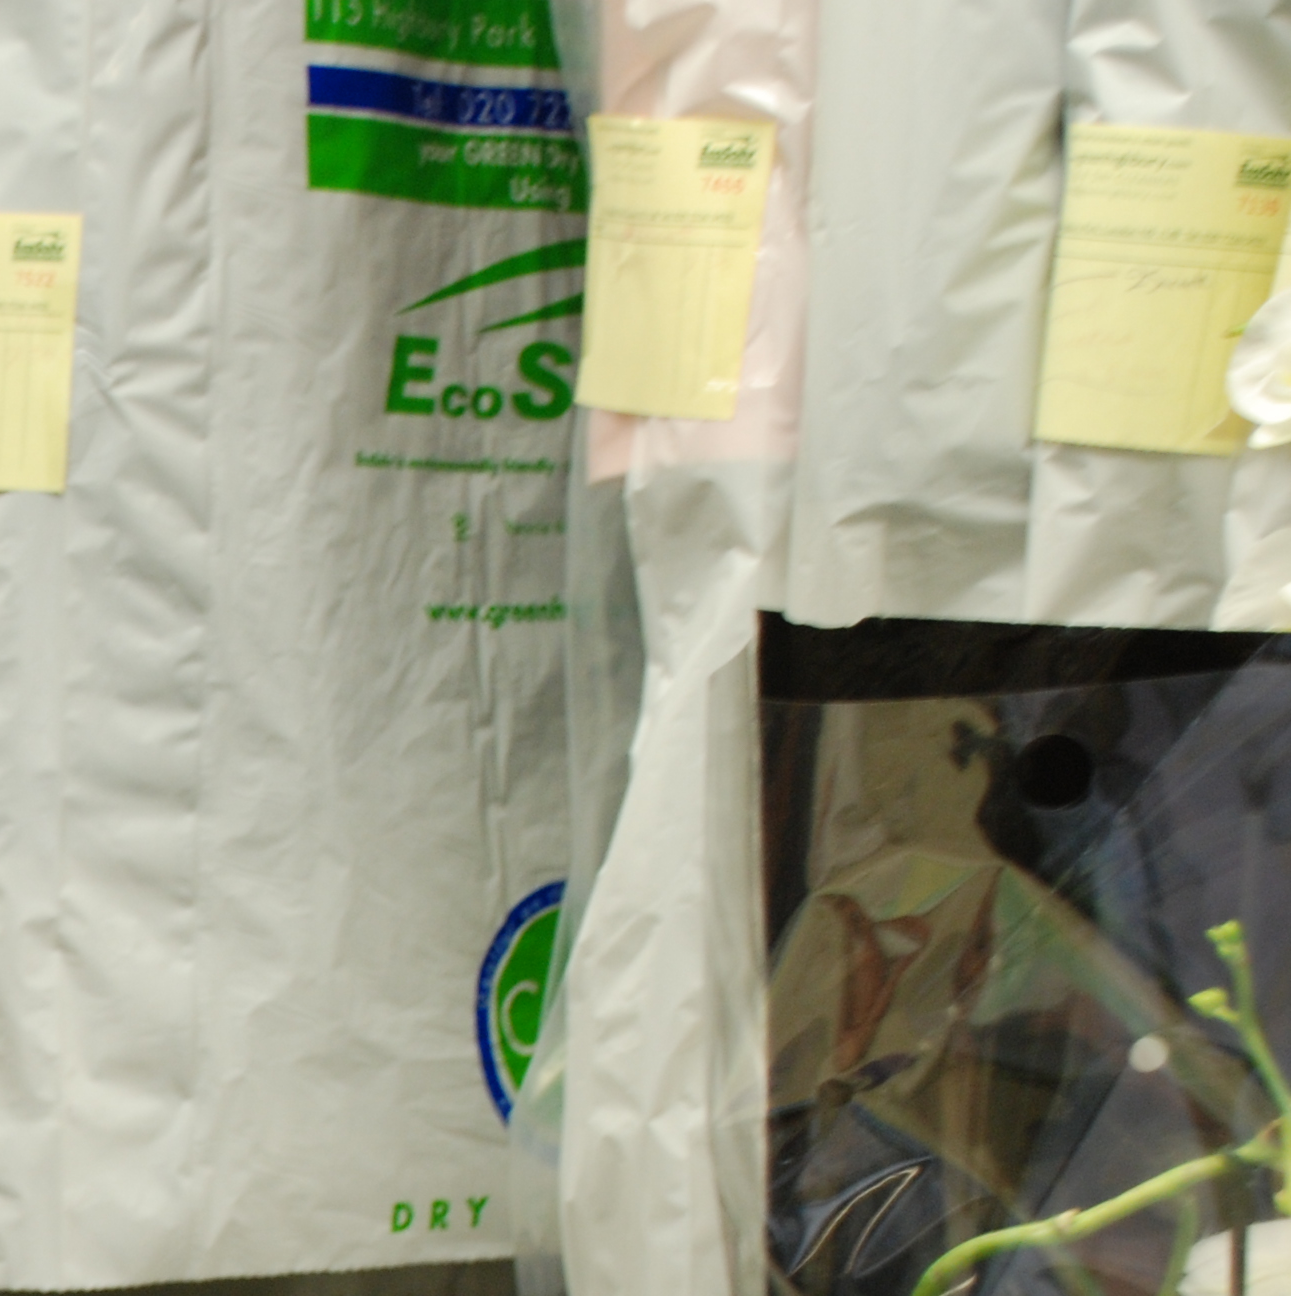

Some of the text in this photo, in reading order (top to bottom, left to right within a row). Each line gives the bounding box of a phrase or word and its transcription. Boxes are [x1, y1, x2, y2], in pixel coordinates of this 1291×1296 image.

[469, 12, 537, 50] Park
[462, 139, 543, 167] GREEN
[385, 333, 572, 421] EcoS
[390, 1195, 491, 1233] DRY
